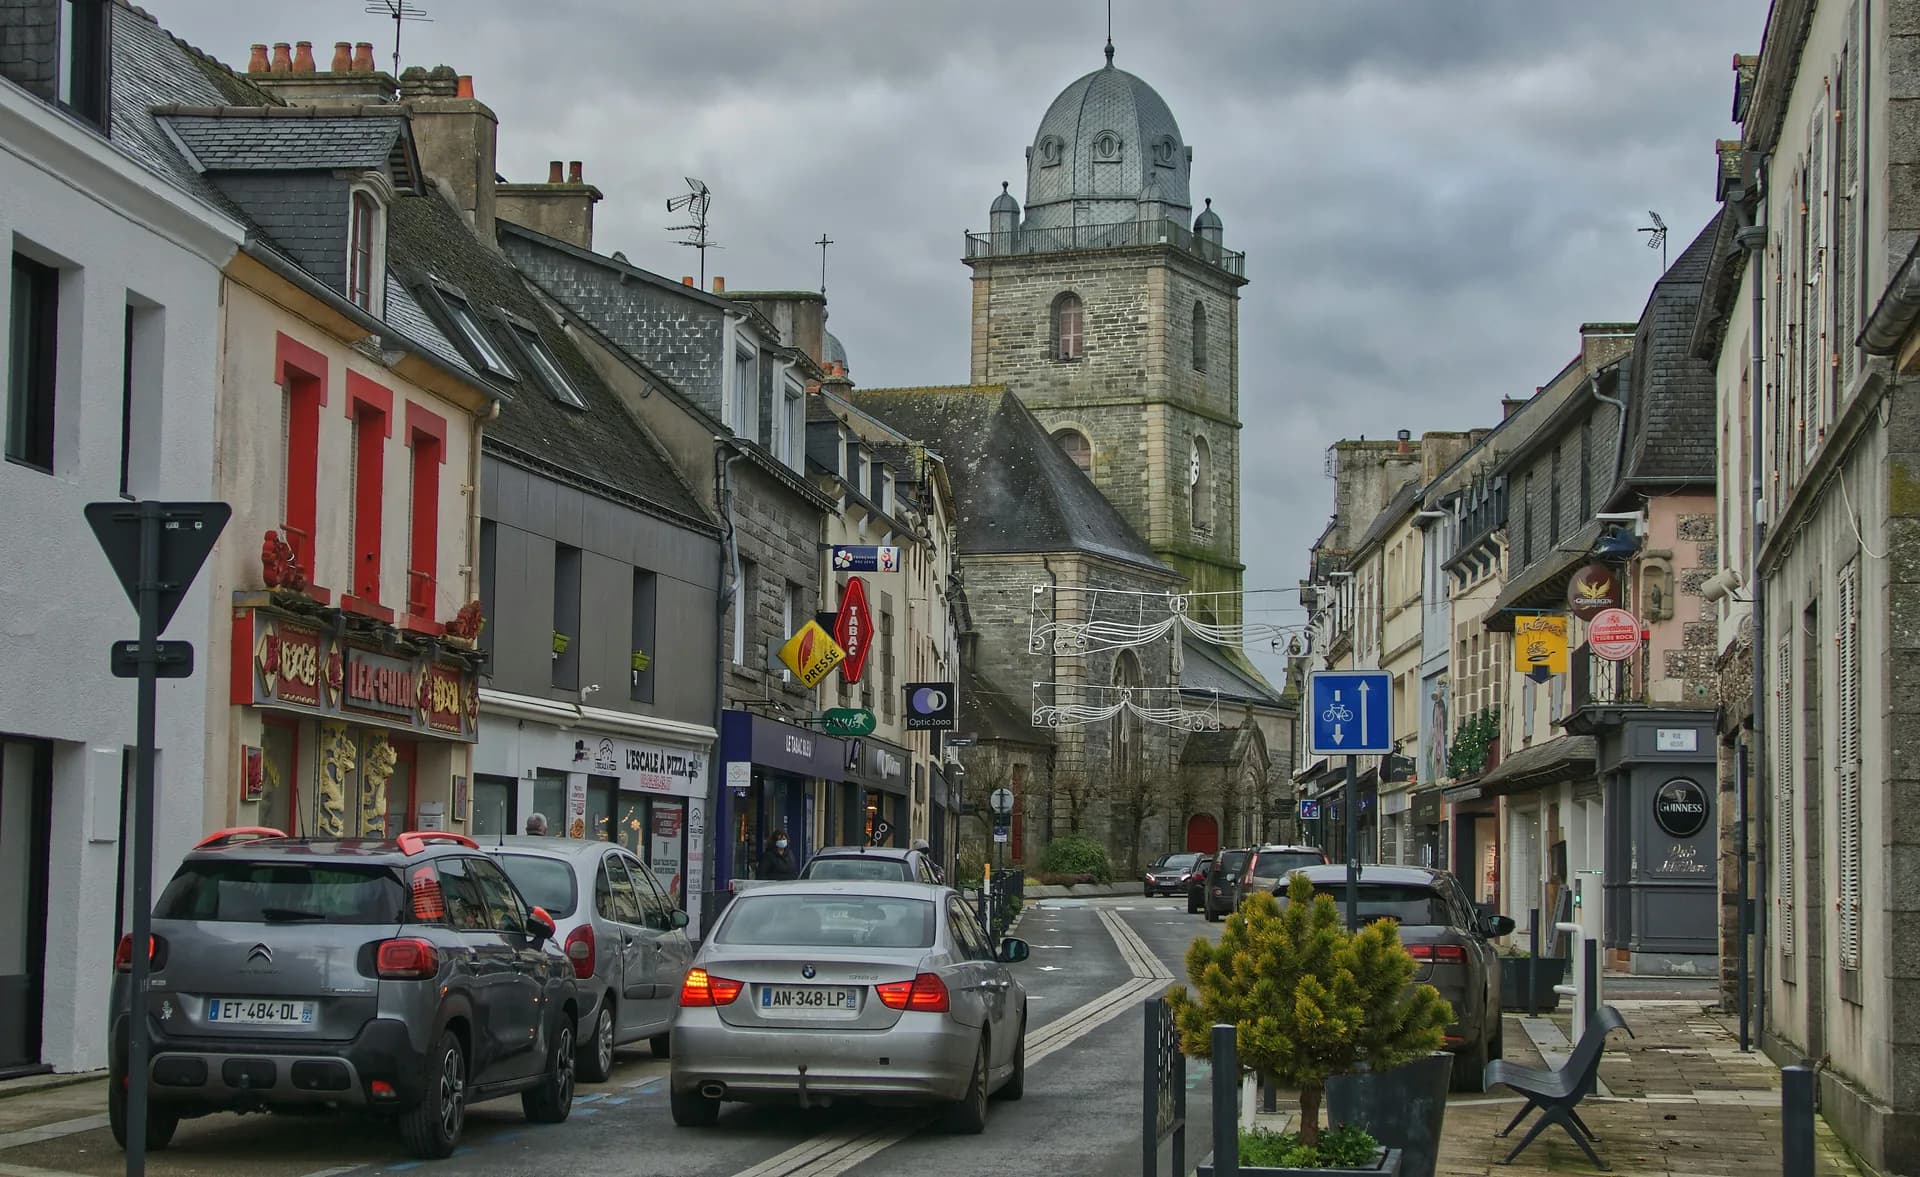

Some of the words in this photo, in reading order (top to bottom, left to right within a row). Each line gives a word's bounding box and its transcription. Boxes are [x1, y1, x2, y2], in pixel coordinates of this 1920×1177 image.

[848, 606, 859, 656] TABAC
[804, 649, 840, 684] PRESSE
[626, 748, 659, 773] L'ESCALE
[660, 748, 666, 775] À
[666, 754, 688, 777] PIZZA
[1660, 801, 1703, 813] GUINNESS
[773, 990, 846, 1006] AN-348-LP
[223, 1002, 299, 1021] ET-484-DL
